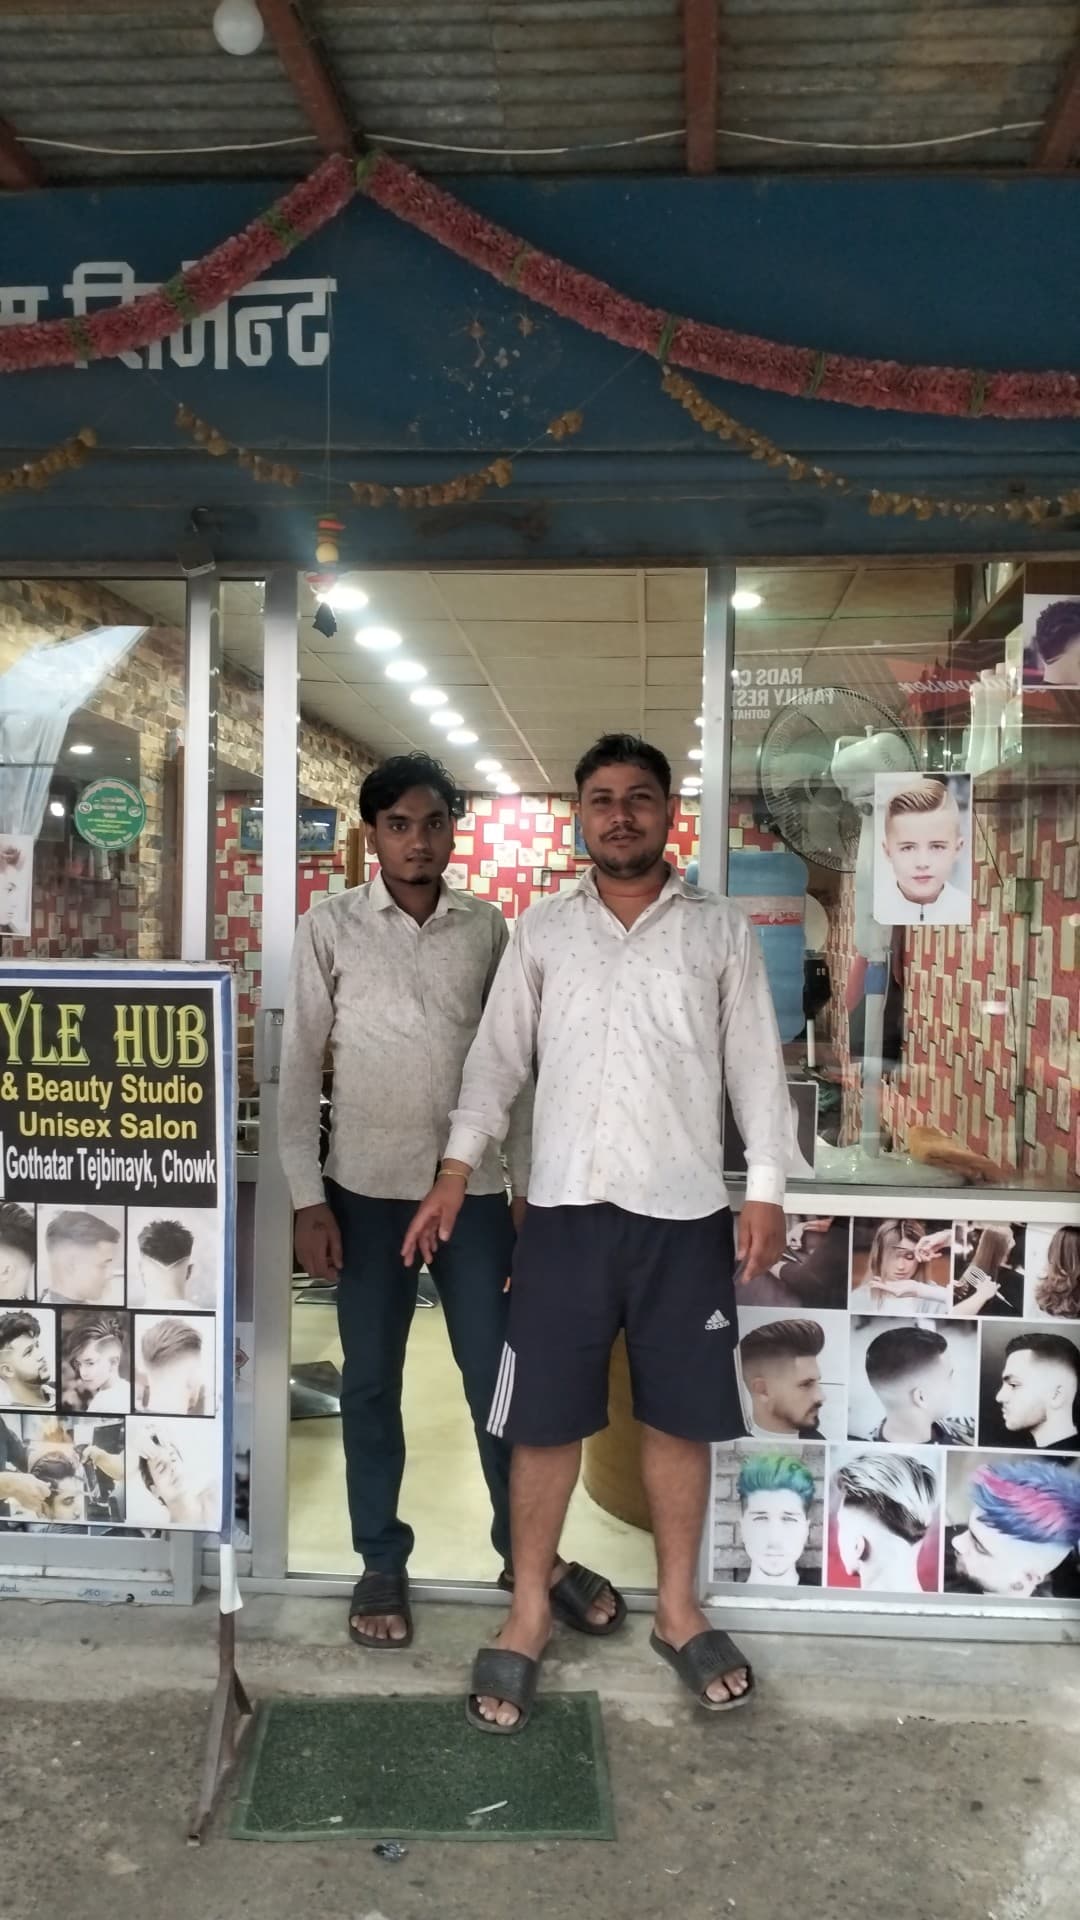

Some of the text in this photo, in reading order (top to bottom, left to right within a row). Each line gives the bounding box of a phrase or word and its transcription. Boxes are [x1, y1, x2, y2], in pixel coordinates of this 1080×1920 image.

[113, 1004, 209, 1068] HUB
[1, 1071, 203, 1111] & Beauty Studio
[19, 1111, 197, 1139] Unisex Salon
[6, 1145, 217, 1191] Gothatar Tejbinayk, Chowk
